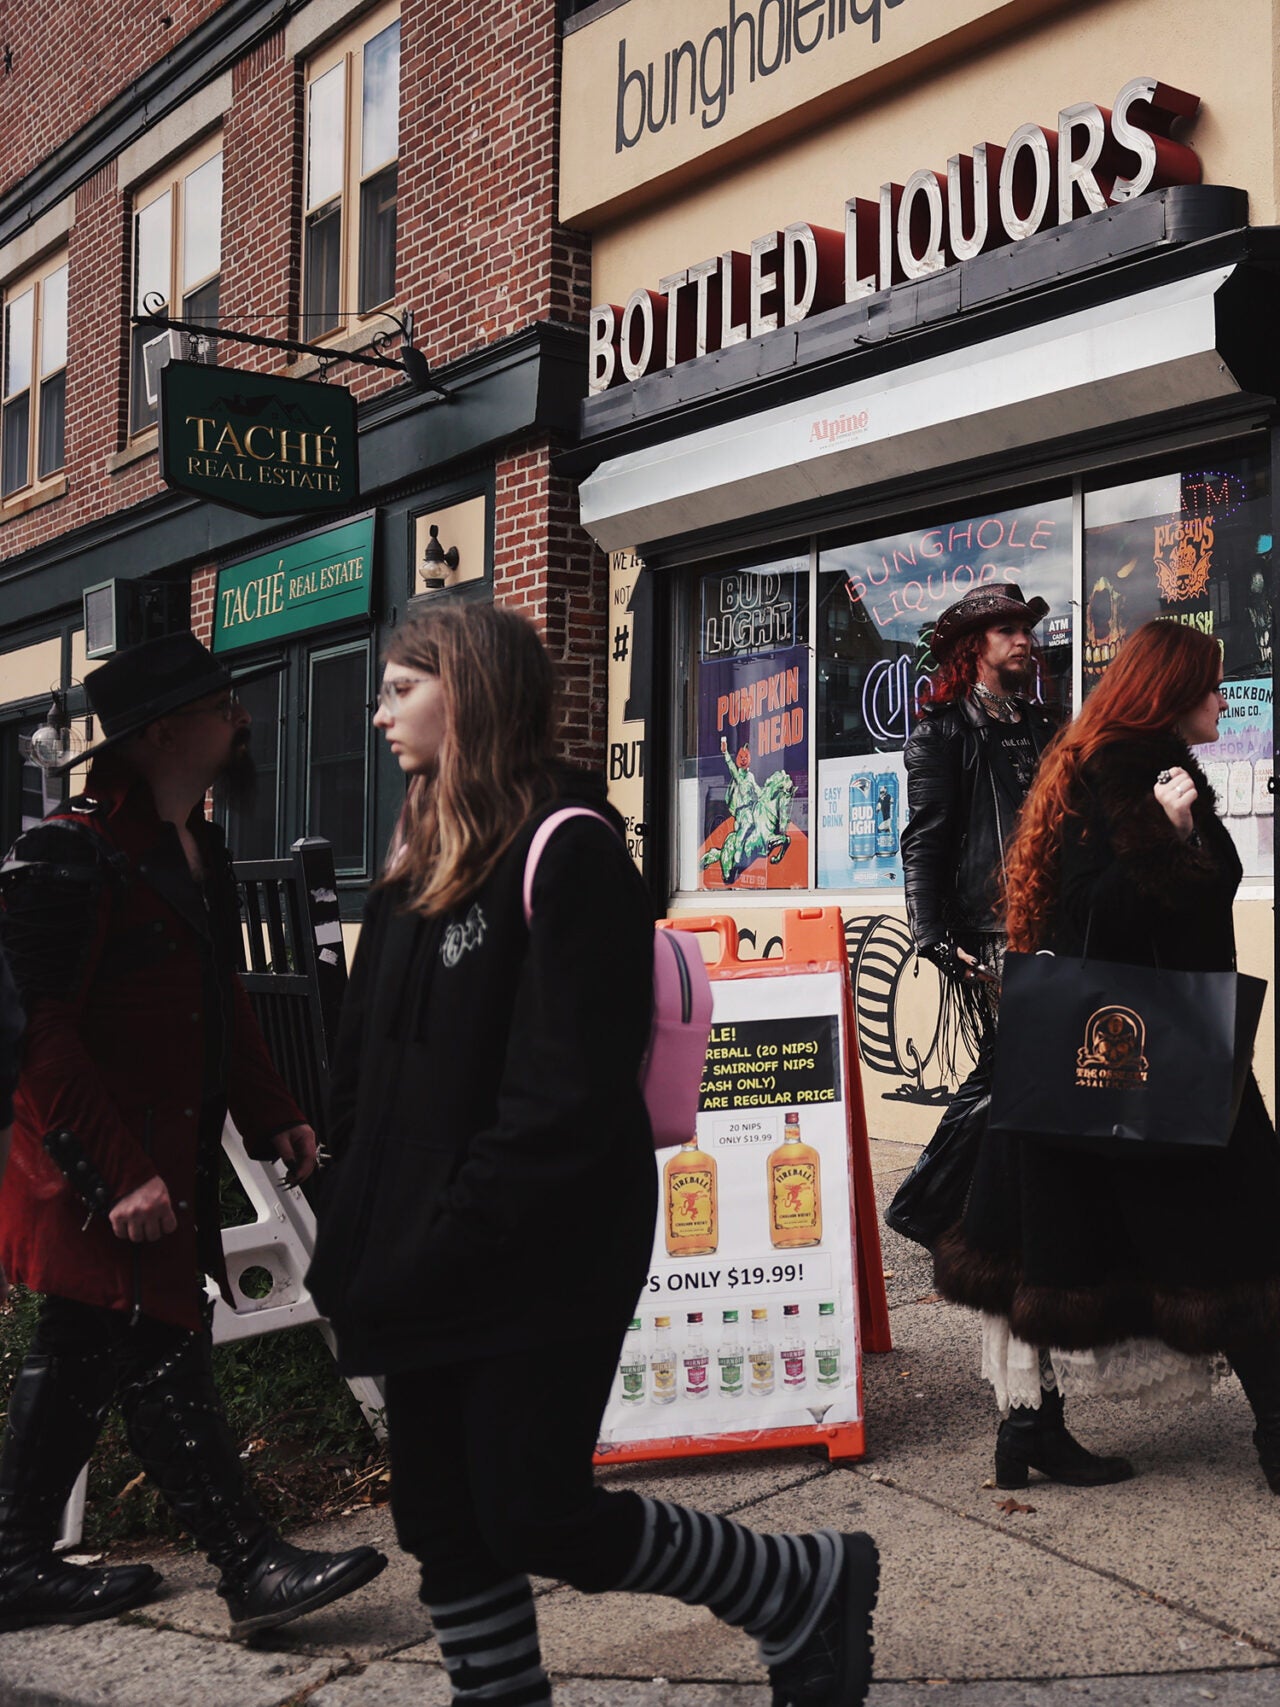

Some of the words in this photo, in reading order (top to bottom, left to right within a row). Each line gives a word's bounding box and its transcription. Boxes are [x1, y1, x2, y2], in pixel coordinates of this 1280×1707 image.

[844, 77, 1160, 302] LIQUORS
[589, 222, 818, 397] BOTTLED
[185, 416, 340, 469] TACHÉ
[188, 457, 252, 481] REAL
[259, 465, 341, 492] ESTATE
[613, 552, 627, 571] WE
[844, 519, 1056, 603] BUNGHOLE
[222, 560, 286, 629] TACHÉ
[288, 571, 318, 600] REAL
[319, 556, 365, 591] ESTATE
[614, 586, 631, 605] NOT
[720, 571, 780, 613] BUD
[707, 602, 792, 653] LIGHT
[1048, 618, 1069, 632] ATM
[717, 666, 799, 731] PUMPKIN
[757, 707, 803, 756] HEAD
[824, 788, 842, 800] EASY
[829, 801, 838, 813] TO
[822, 815, 843, 828] DRINK
[756, 1045, 778, 1059] (20
[782, 1041, 818, 1055] NIPS)
[713, 1062, 779, 1076] SMIRNOFF
[783, 1059, 815, 1071] NIPS
[737, 1076, 776, 1090] ONLY)
[704, 1096, 728, 1109] ARE
[734, 1092, 792, 1106] REGULAR
[797, 1089, 835, 1101] PRICE
[729, 1124, 740, 1132] 20
[742, 1122, 762, 1131] NIPS
[719, 1135, 741, 1144] ONLY
[743, 1133, 772, 1143] $19.99
[673, 1177, 709, 1191] FIREBALL
[776, 1169, 812, 1183] FIREBALL
[667, 1270, 721, 1290] ONLY
[727, 1263, 804, 1288] $19.99!
